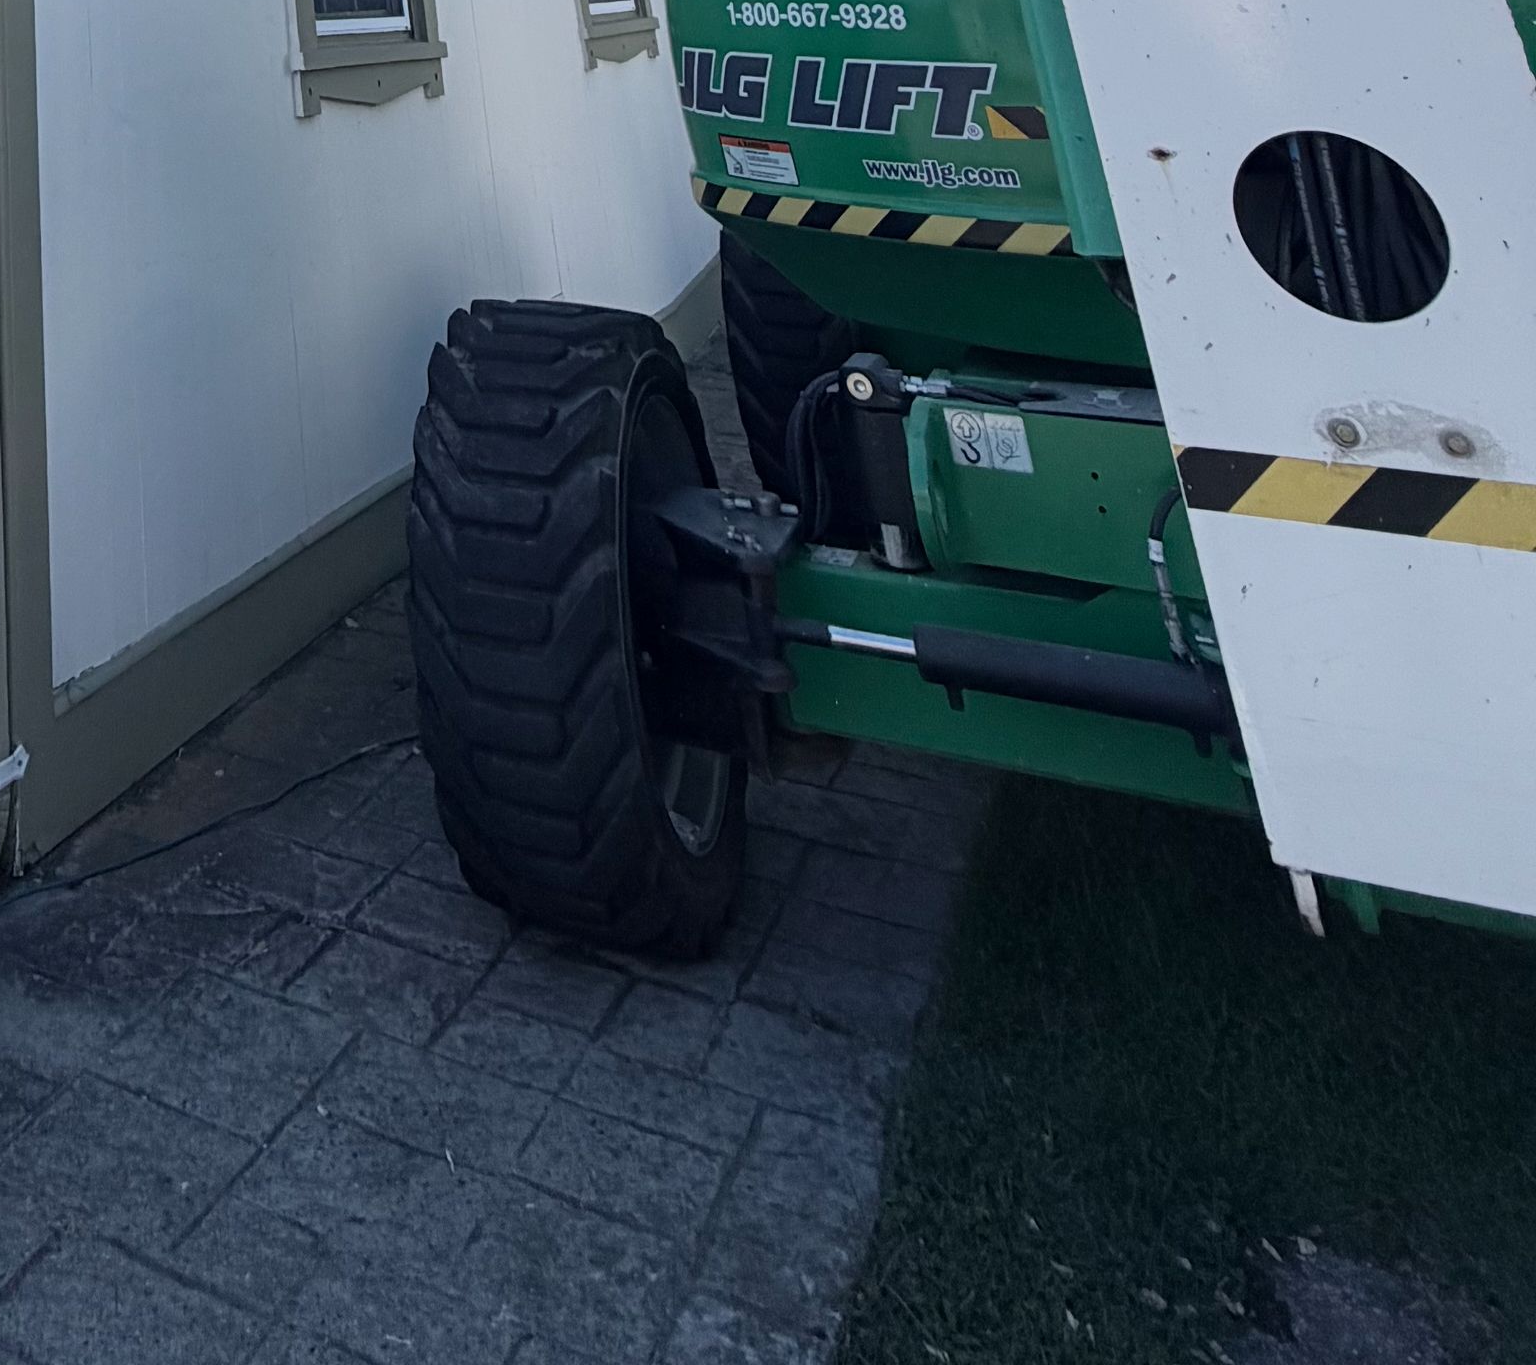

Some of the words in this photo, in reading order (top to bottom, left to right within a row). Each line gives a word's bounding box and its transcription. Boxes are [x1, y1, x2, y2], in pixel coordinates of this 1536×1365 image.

[725, 1, 907, 31] 1-800-667-9328
[678, 46, 773, 123] JLG
[787, 55, 998, 140] LIFT
[862, 158, 1021, 189] www.jlg.com
